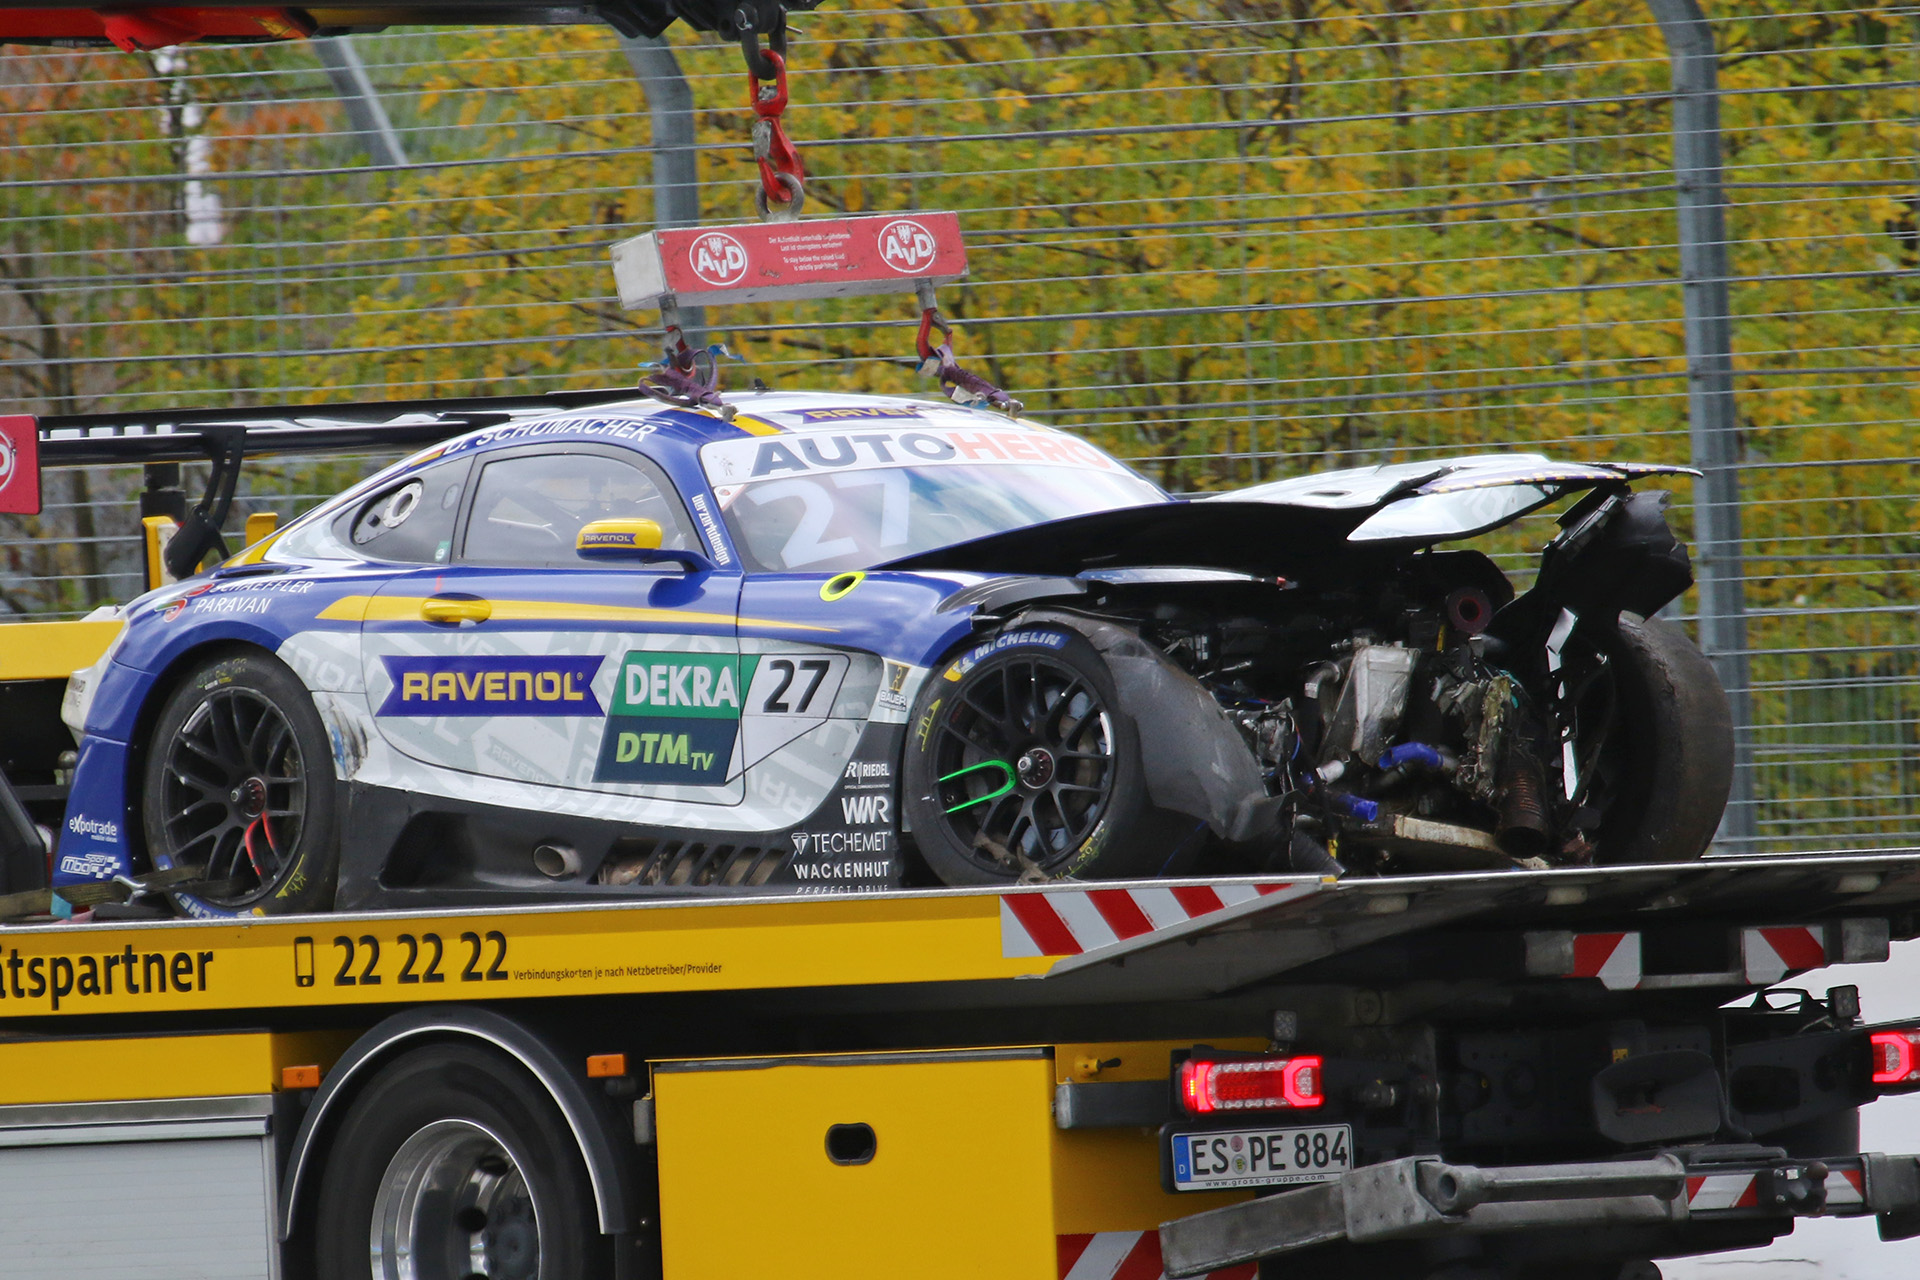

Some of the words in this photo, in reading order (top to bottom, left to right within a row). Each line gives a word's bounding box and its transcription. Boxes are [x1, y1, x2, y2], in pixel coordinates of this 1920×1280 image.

[476, 418, 659, 446] SCHUMACHER
[749, 432, 1110, 478] AUTOHERO
[745, 469, 911, 569] 27
[584, 534, 631, 542] RAVENOL
[193, 597, 272, 614] PARAVAN
[974, 631, 1061, 661] MICHELIN
[625, 663, 739, 708] DEKRA
[762, 658, 831, 714] 27
[880, 690, 906, 705] BAUER
[615, 732, 689, 765] DTM
[691, 753, 714, 771] TV
[862, 763, 890, 778] RIEDEL
[793, 861, 889, 880] WACKENHUT
[333, 935, 382, 986] 22
[396, 933, 445, 983] 22
[460, 930, 509, 981] 22
[604, 965, 625, 978] nach
[626, 963, 723, 977] Netzbetreiber/Provider
[1190, 1138, 1230, 1176] ES
[1248, 1135, 1287, 1172] PE
[1293, 1130, 1348, 1169] 884
[1204, 1173, 1326, 1188] www.gross-gruppe.com
